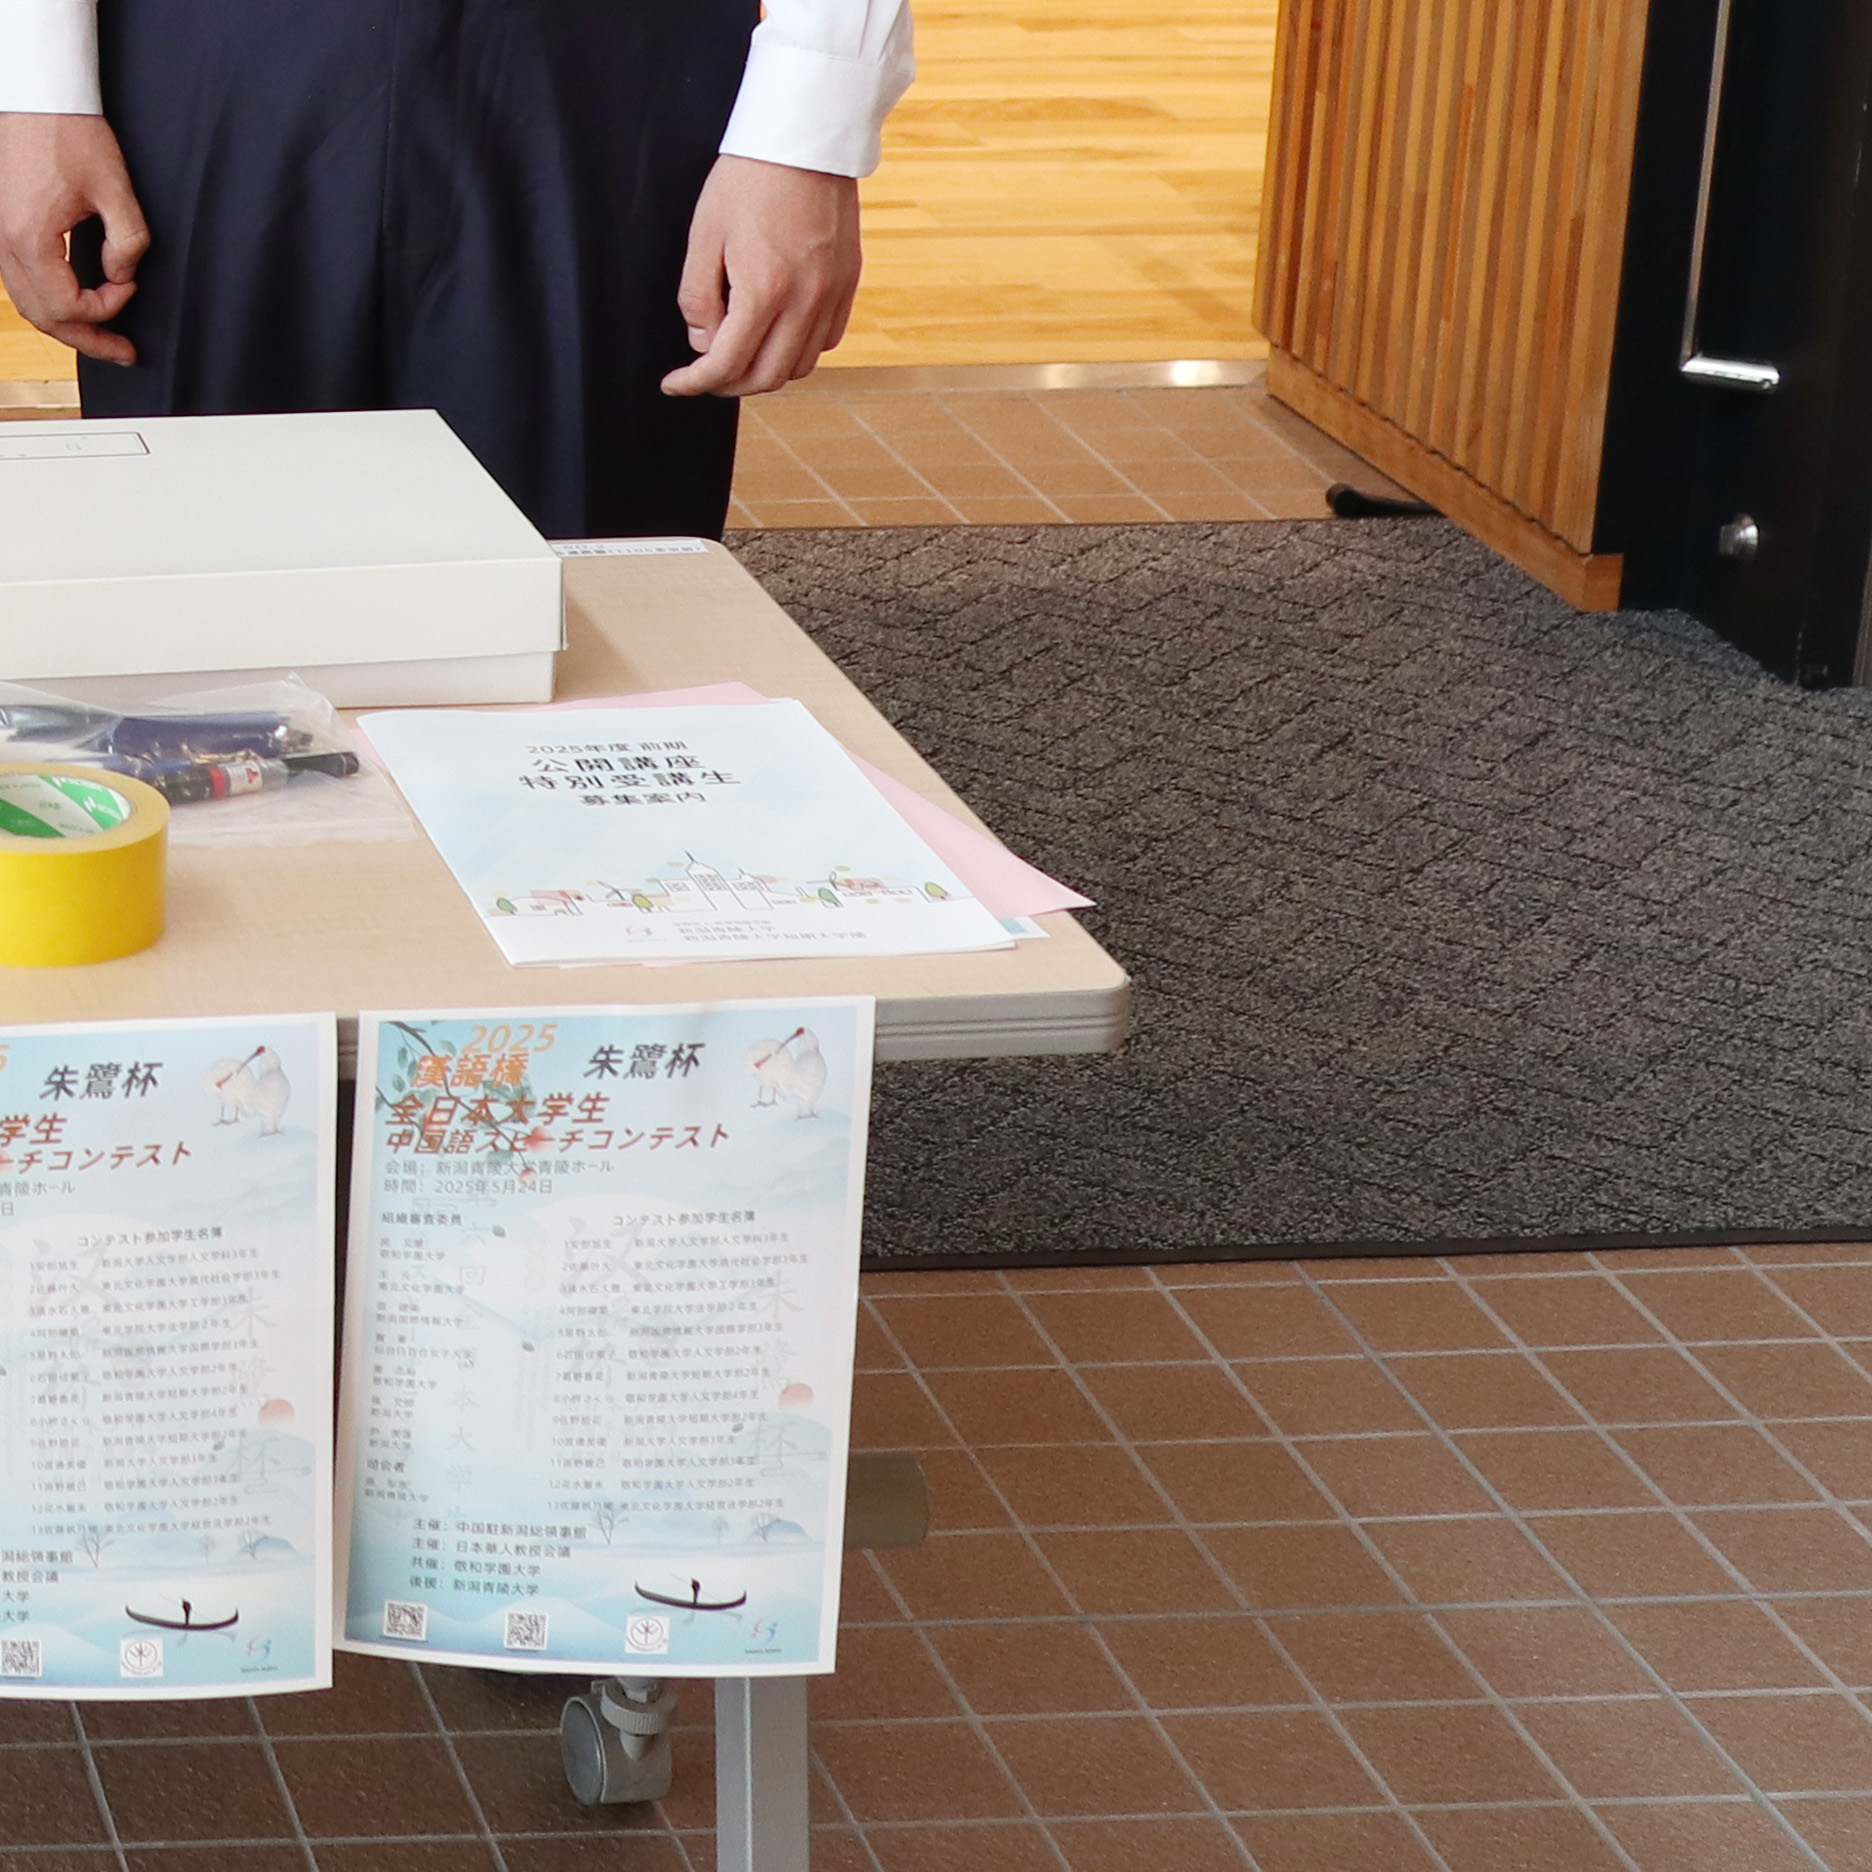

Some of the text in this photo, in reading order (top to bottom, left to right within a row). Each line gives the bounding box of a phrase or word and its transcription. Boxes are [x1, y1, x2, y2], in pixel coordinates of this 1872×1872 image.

[526, 739, 689, 755] 2025年度 前期
[531, 754, 706, 773] 公開講座
[518, 769, 743, 790] 特別受講生
[578, 791, 708, 807] 募集案内
[462, 1023, 559, 1054] 2025
[411, 1043, 705, 1088] 漢語橋 朱鷺杯
[40, 1062, 162, 1100] 朱鷺杯
[385, 1094, 610, 1126] 全日本大学生
[385, 1123, 730, 1155] 中国語スピーチコンテスト
[382, 1213, 462, 1226] 組織審査委員
[613, 1210, 756, 1226] コンテスト参加学生名簿
[78, 1228, 224, 1247] コンテスト参加学生名簿
